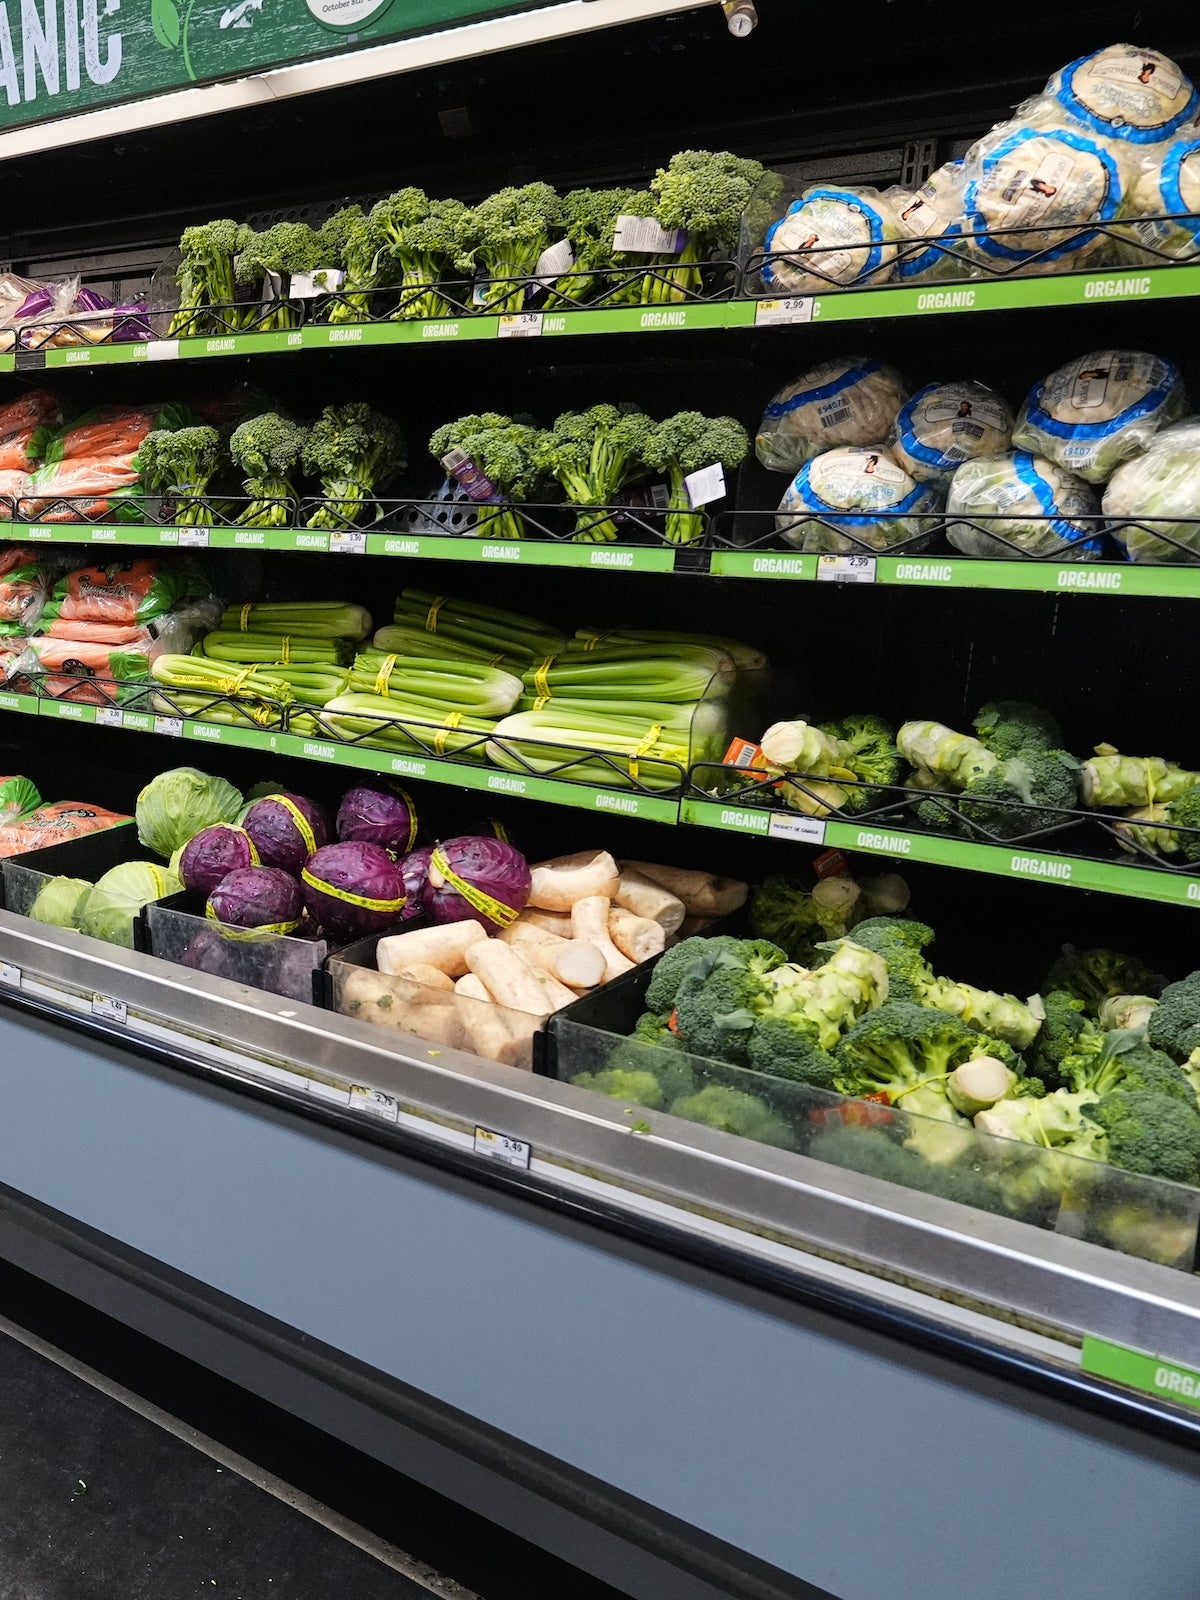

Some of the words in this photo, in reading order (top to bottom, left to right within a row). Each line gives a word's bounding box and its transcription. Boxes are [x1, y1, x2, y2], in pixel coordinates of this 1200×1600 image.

[1084, 277, 1151, 299] ORGANIC
[917, 291, 976, 310] ORGANIC
[543, 318, 566, 332] ANIC
[640, 312, 687, 328] ORGANIC
[329, 329, 363, 342] ORGANIC
[422, 324, 460, 338] ORGANIC
[207, 339, 236, 352] ORGANIC
[66, 350, 90, 363] ORGANIC
[28, 528, 52, 539] ORGANIC
[92, 529, 117, 541] ORGANIC
[235, 533, 265, 545] ORGANIC
[296, 535, 328, 548] ORGANIC
[384, 540, 420, 554] ORGANIC
[482, 545, 521, 560] ORGANIC
[590, 551, 635, 567] ORGANIC
[753, 558, 804, 575] ORGANIC
[895, 564, 952, 582] ORGANIC
[1057, 569, 1122, 589] ORGANIC
[59, 704, 83, 718] ORGANIC
[123, 714, 149, 728] ORGANIC
[193, 725, 222, 740] ORGANIC
[303, 743, 335, 759] ORGANIC
[391, 758, 427, 775] ORGANIC
[488, 776, 527, 794] ORGANIC
[596, 795, 639, 814] ORGANIC
[721, 810, 768, 830] ORGANIC
[857, 832, 911, 854] ORGANIC
[1011, 856, 1071, 880] ORGANIC
